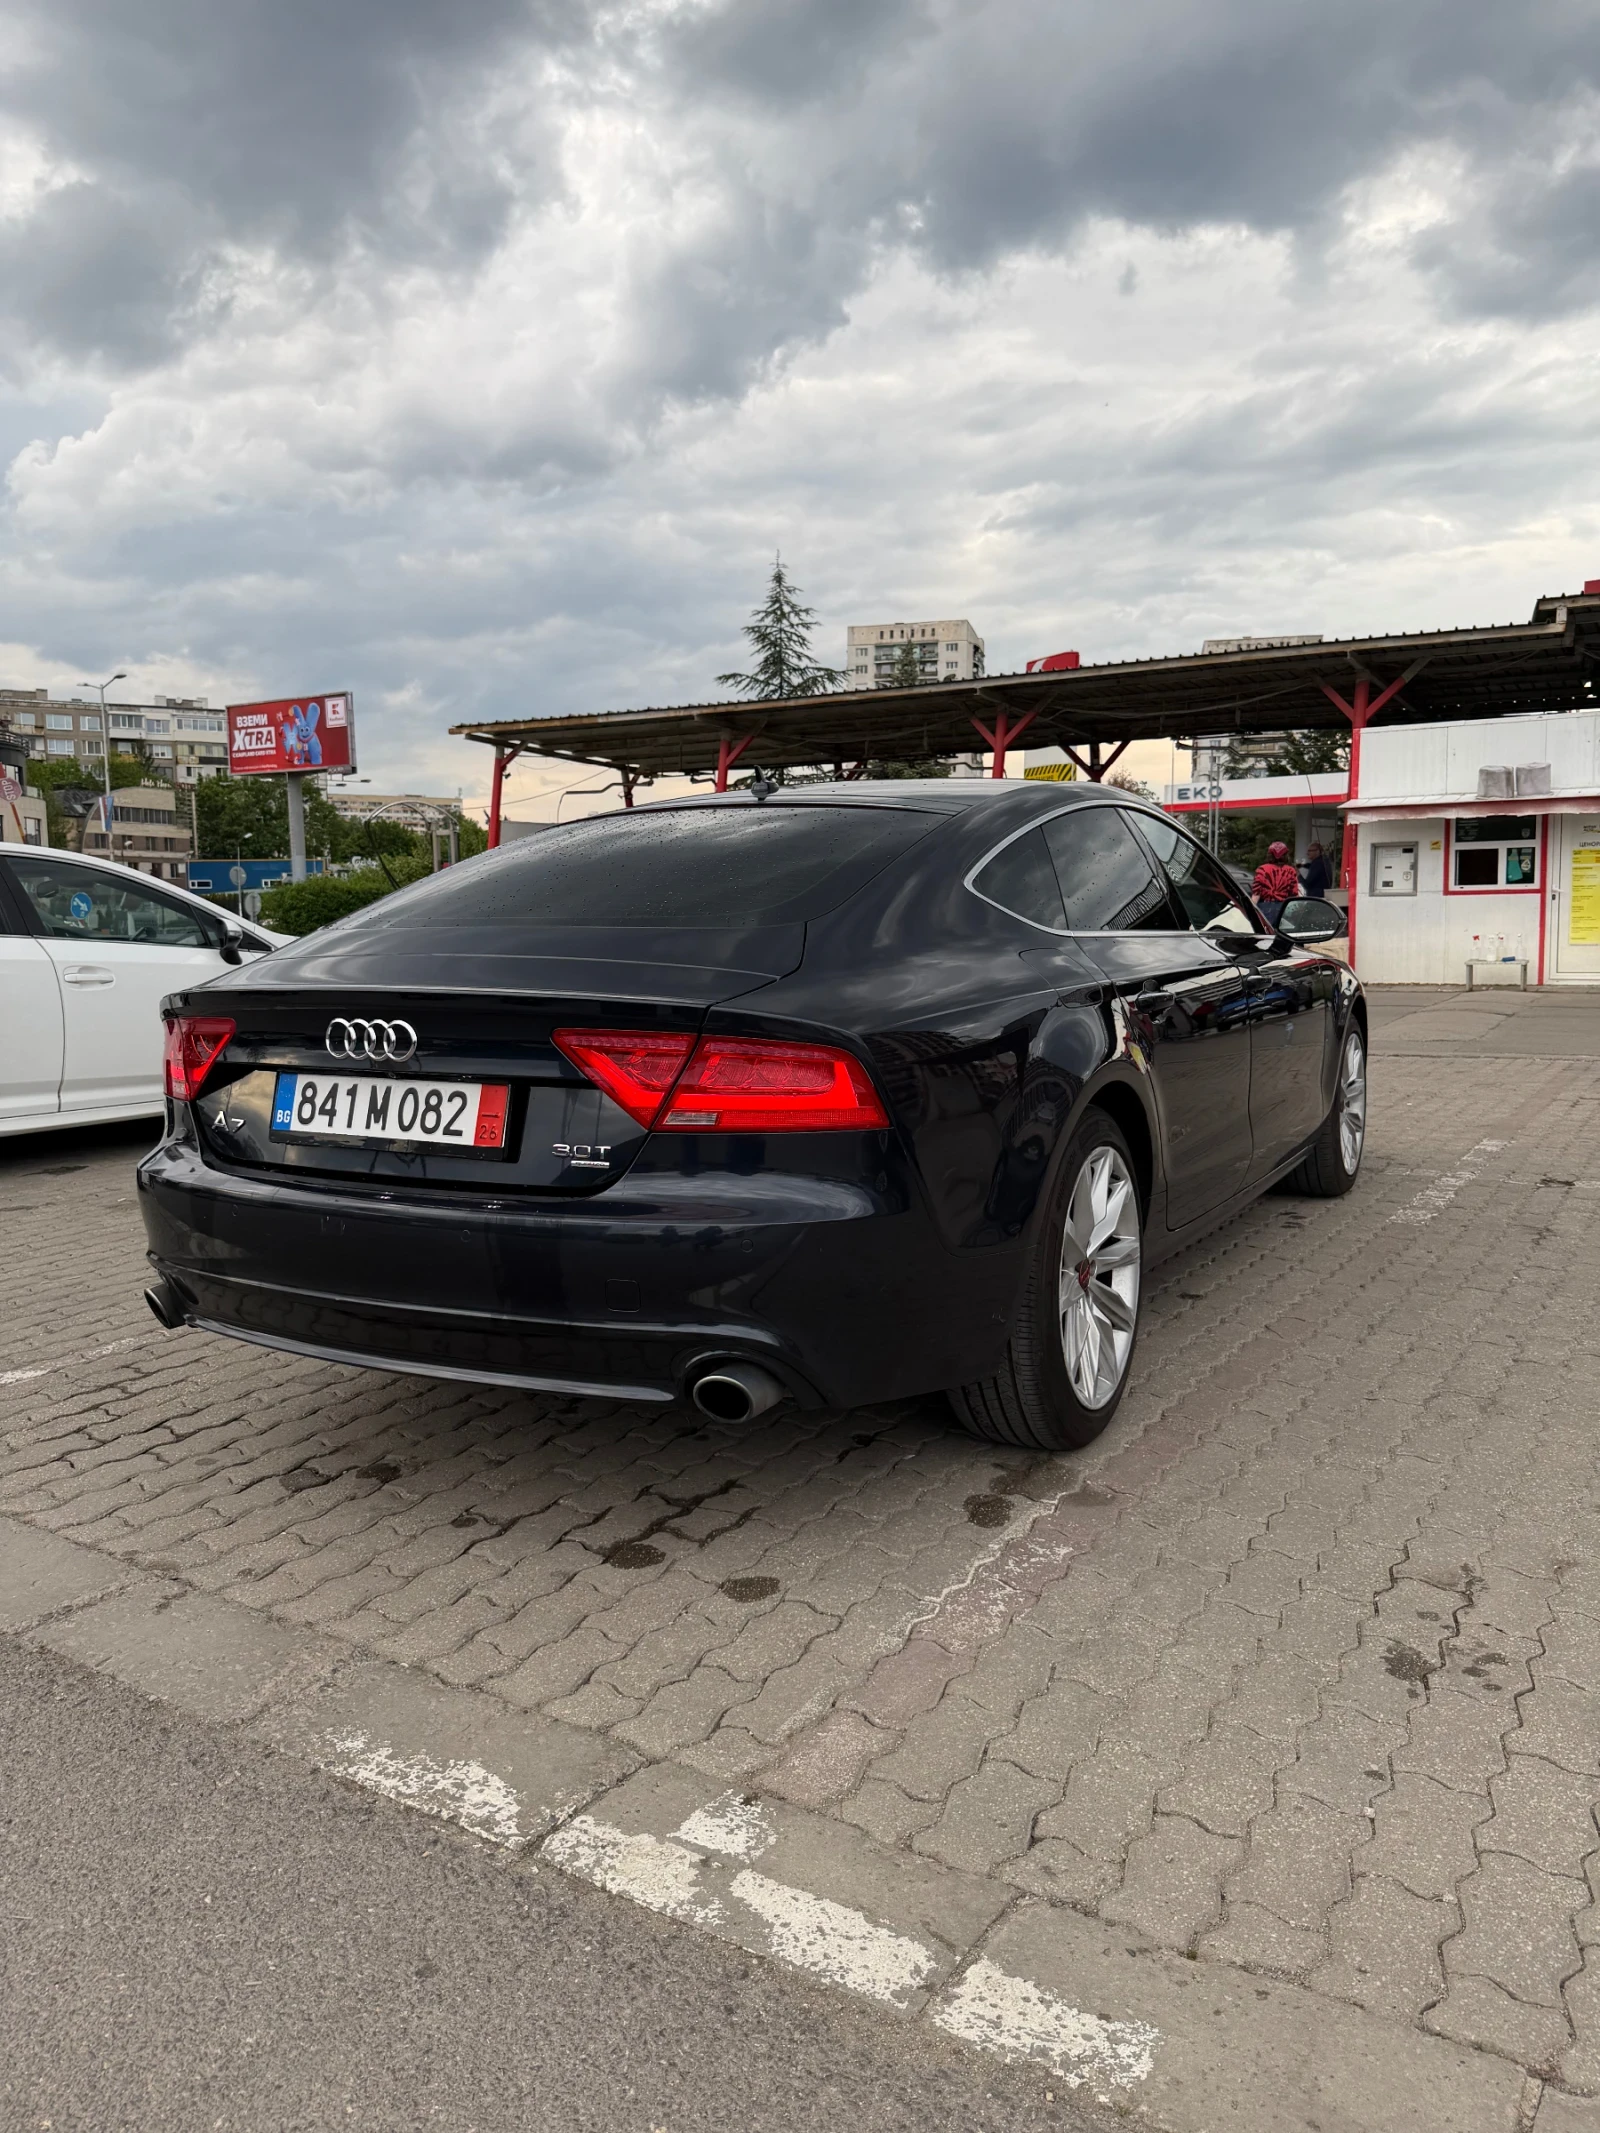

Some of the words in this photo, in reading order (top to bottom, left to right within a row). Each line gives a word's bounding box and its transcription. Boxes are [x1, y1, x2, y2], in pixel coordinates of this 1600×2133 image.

[236, 714, 268, 728] ВЗЕМИ
[232, 728, 276, 751] XTRA
[1, 779, 16, 800] STOP
[1177, 786, 1222, 800] EKO
[211, 1110, 245, 1132] A7
[276, 1109, 291, 1123] BG
[479, 1124, 497, 1140] 26
